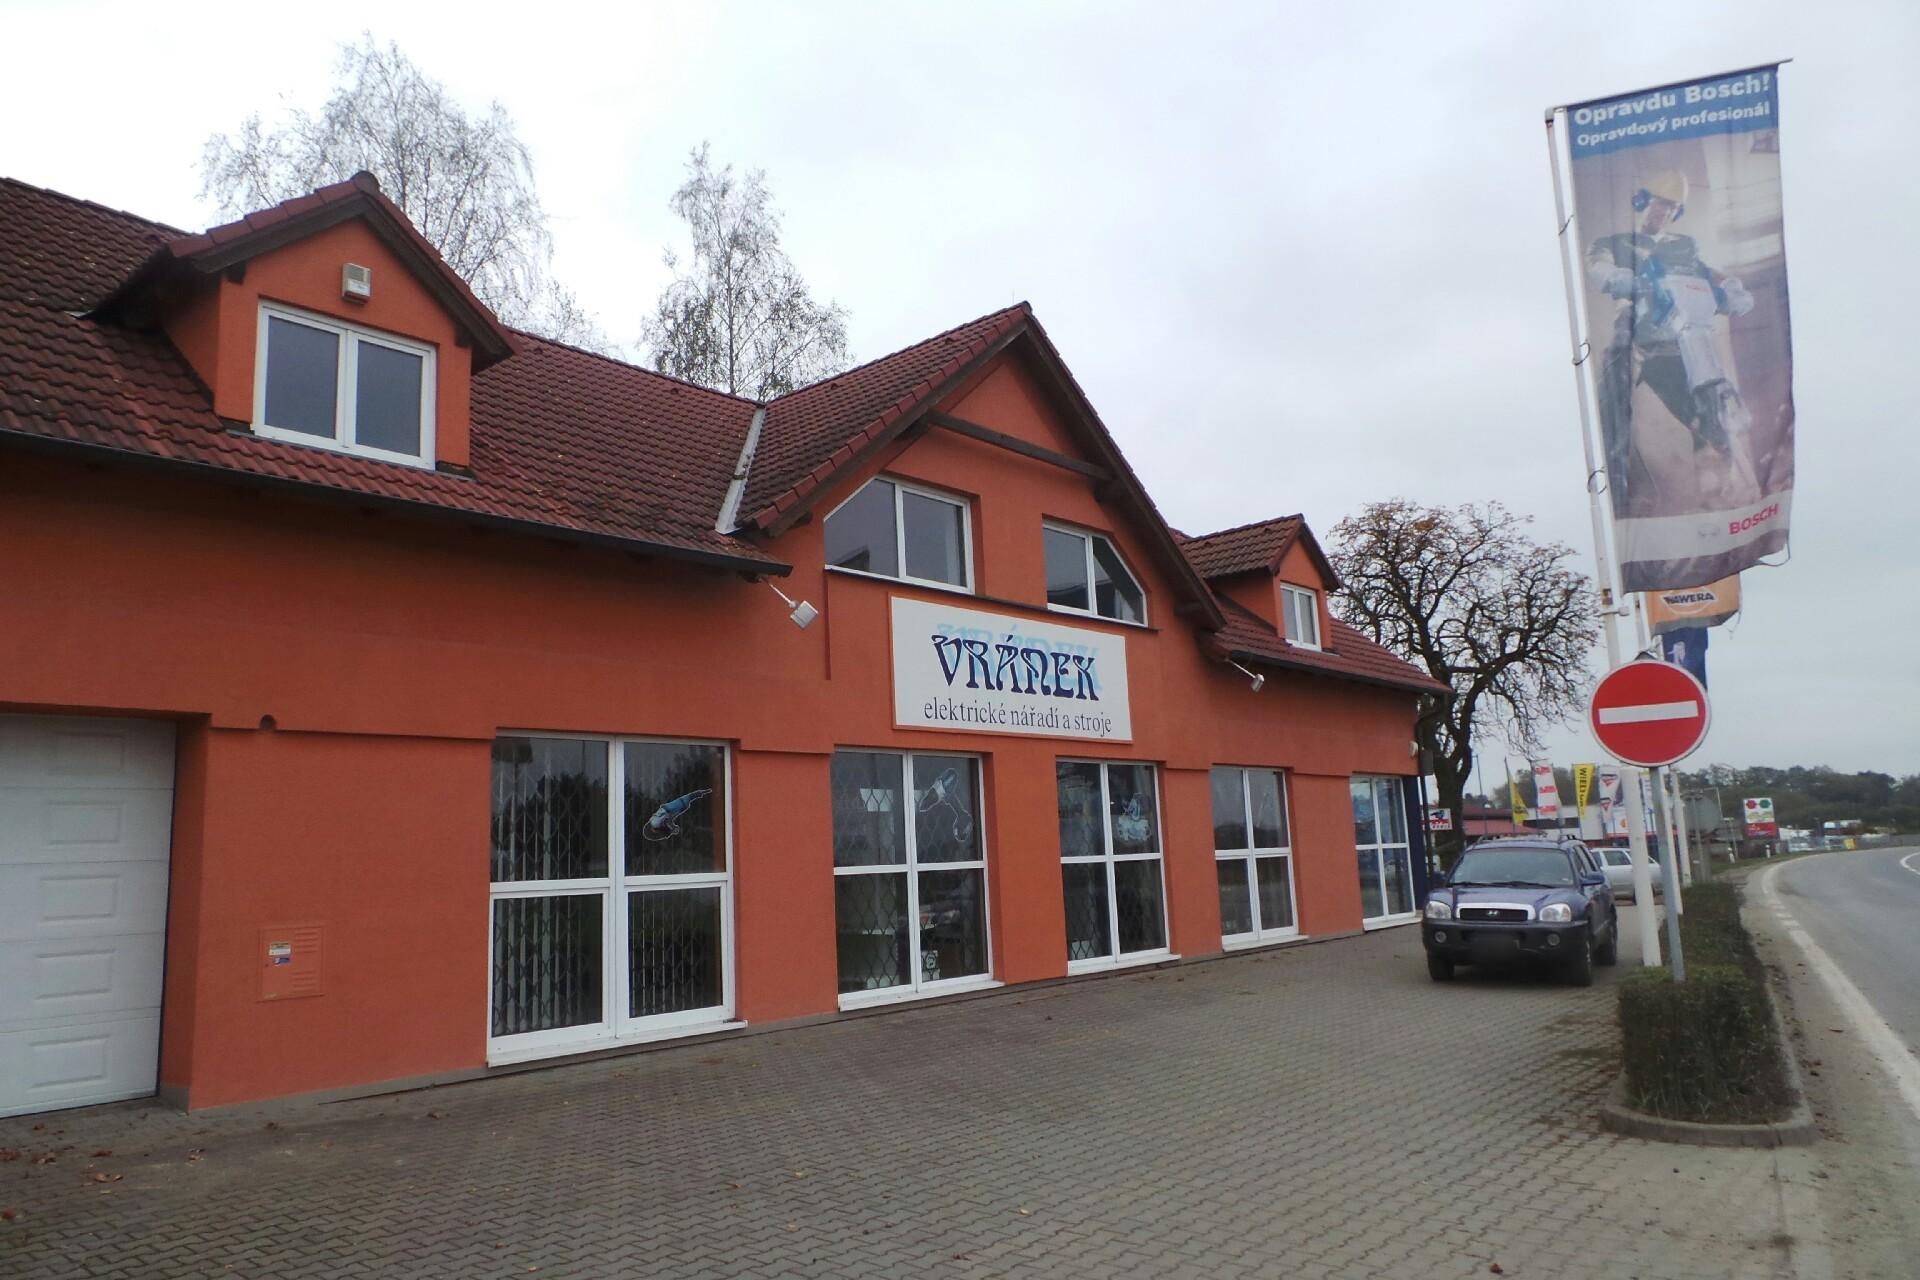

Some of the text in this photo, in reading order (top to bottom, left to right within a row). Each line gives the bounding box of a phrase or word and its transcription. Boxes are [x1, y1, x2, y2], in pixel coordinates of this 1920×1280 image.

[1574, 74, 1771, 126] Opravdu Bosch!
[1577, 101, 1770, 146] Opravdový profesionál
[1729, 503, 1779, 535] BOSCH
[931, 634, 1100, 701] VRÁNEK
[924, 697, 1112, 737] elektrické nářadí a stroje
